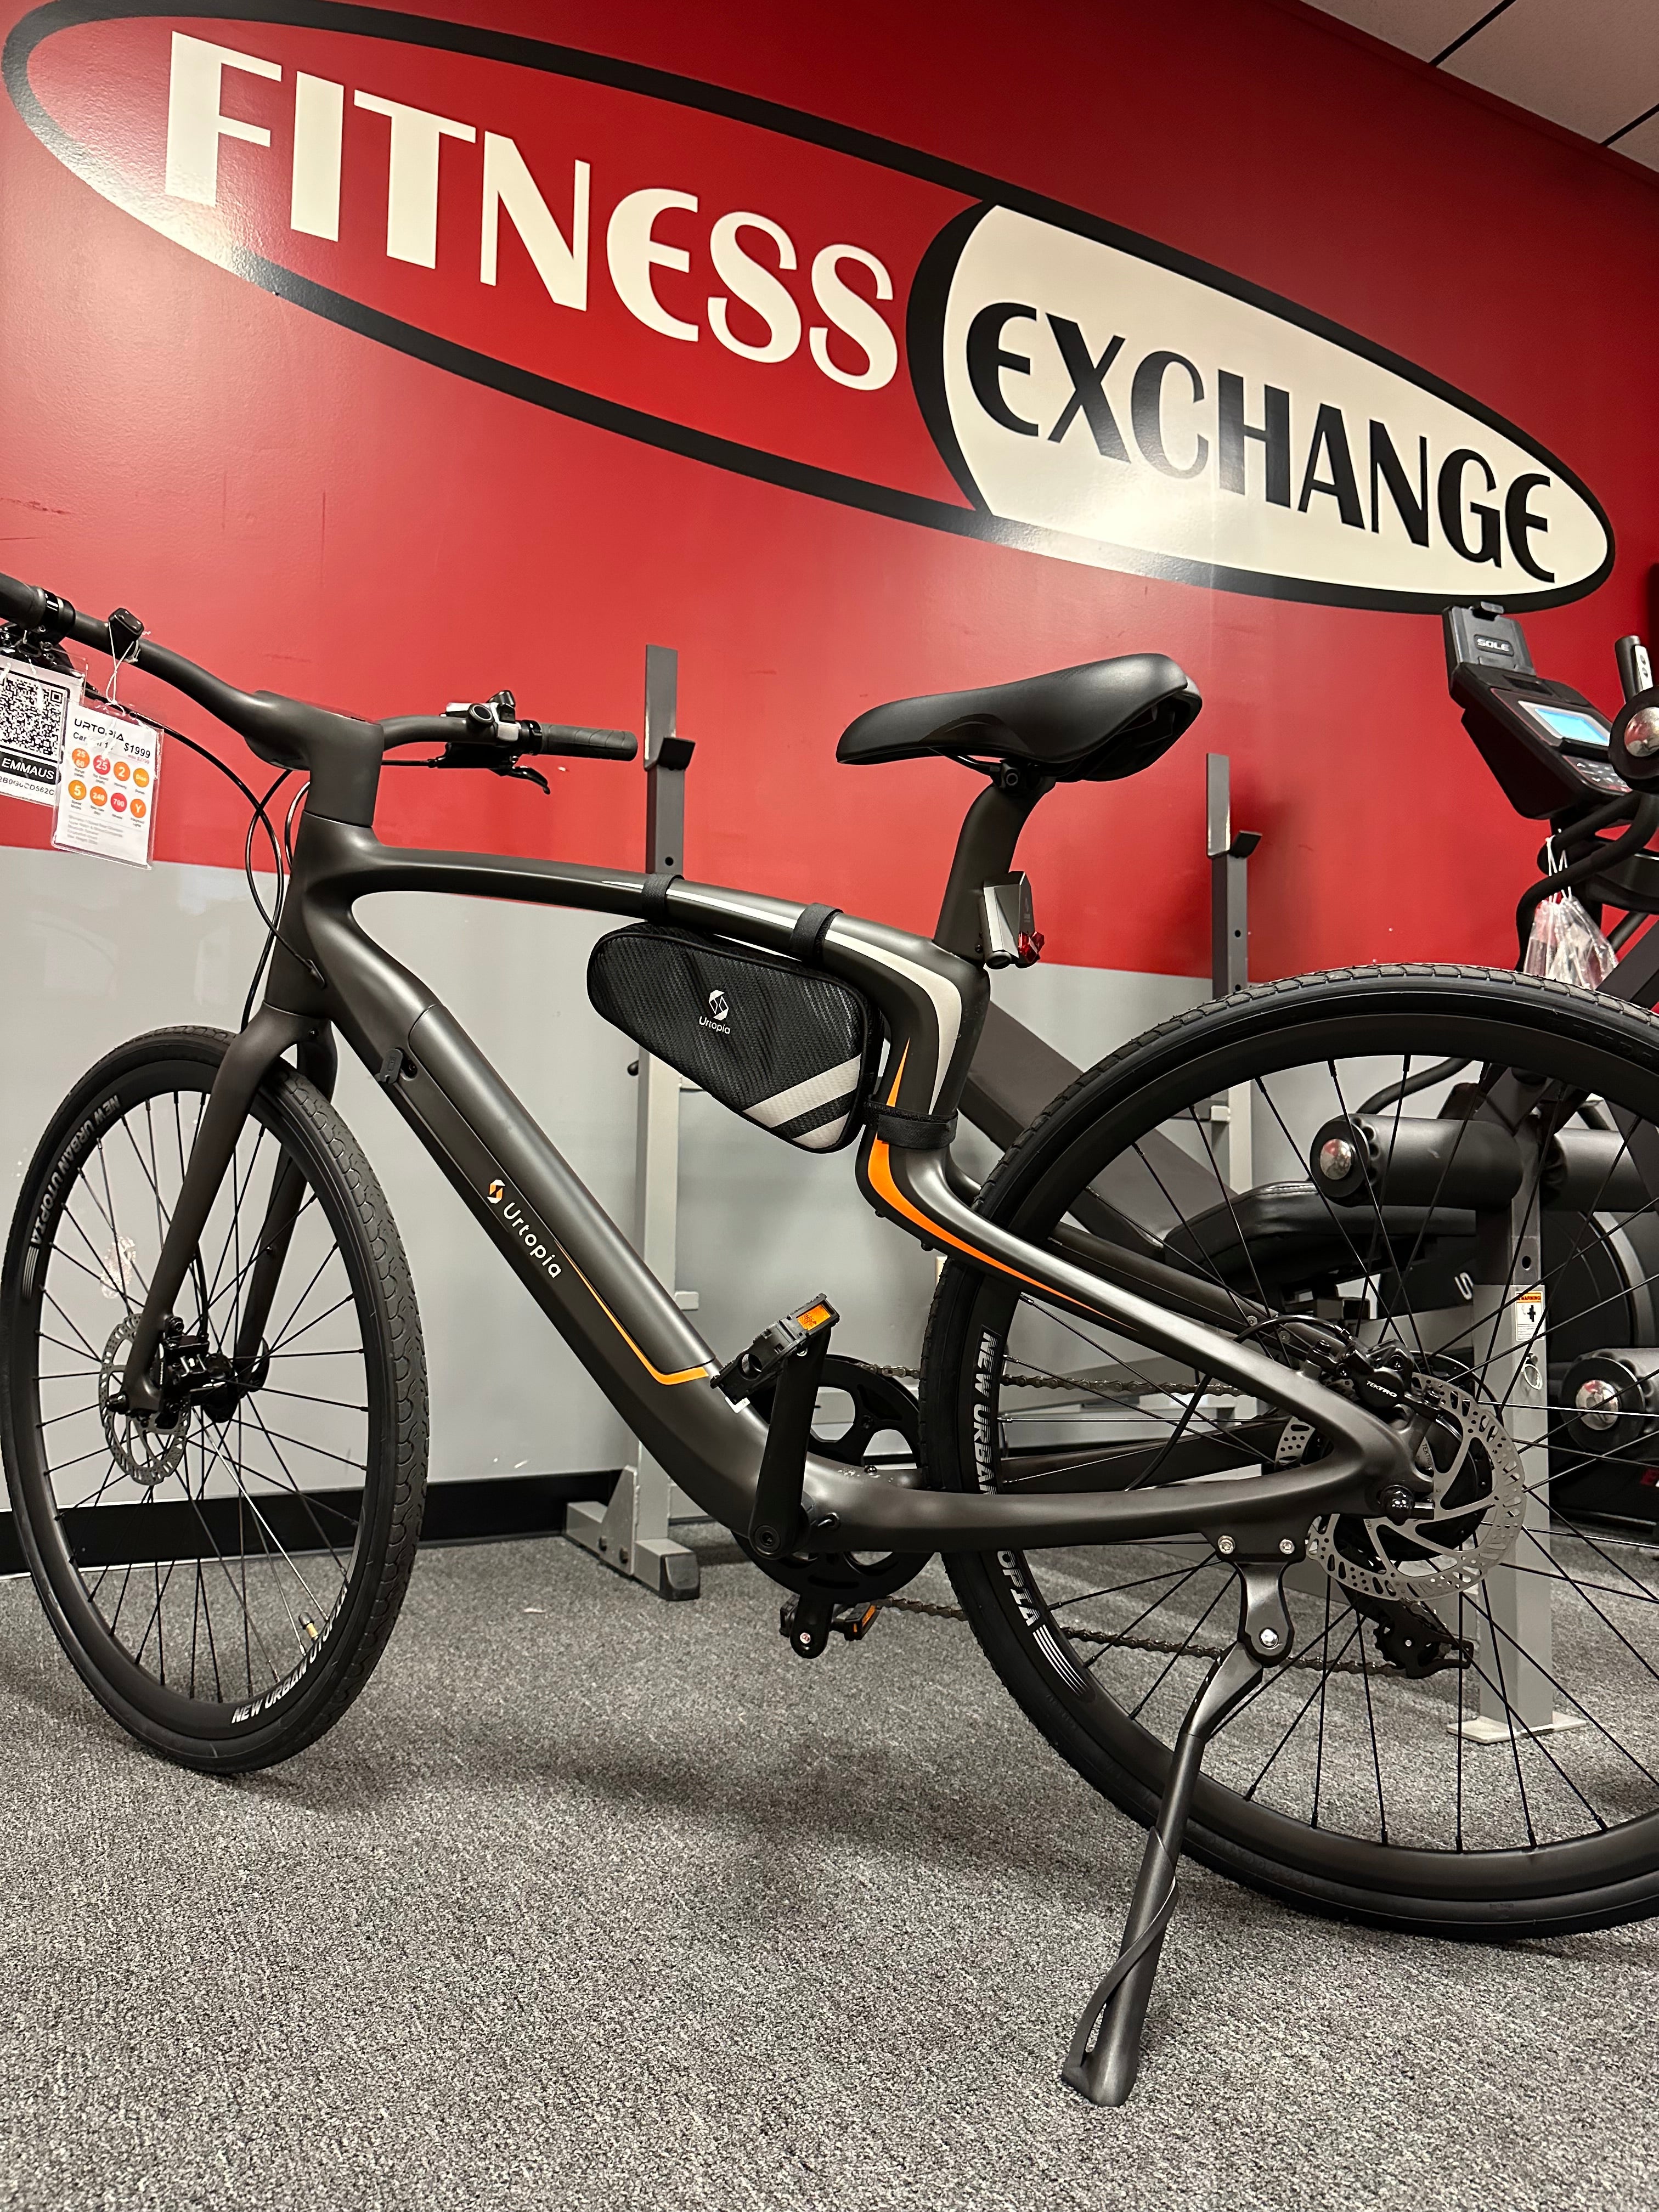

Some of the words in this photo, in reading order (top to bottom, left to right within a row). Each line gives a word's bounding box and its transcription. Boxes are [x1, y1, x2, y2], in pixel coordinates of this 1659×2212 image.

[165, 31, 898, 391] FITNESS
[966, 302, 1555, 583] EXCHANGE
[1477, 638, 1509, 651] SOLE
[123, 742, 150, 758] $1999
[2, 758, 55, 779] EMMAUS
[96, 759, 108, 771] 25
[118, 766, 126, 777] 2
[74, 785, 82, 796] 5
[135, 803, 142, 813] Y
[699, 1015, 731, 1034] Urtopia
[94, 1095, 121, 1125] NEW
[58, 1120, 95, 1175] URBAN
[31, 1172, 63, 1244] UTOPIA
[504, 1202, 562, 1278] Urtopia
[975, 1332, 998, 1398] NEW
[1367, 1380, 1397, 1397] TEKTRO
[232, 1699, 263, 1724] NEW
[264, 1657, 307, 1709] URBAN
